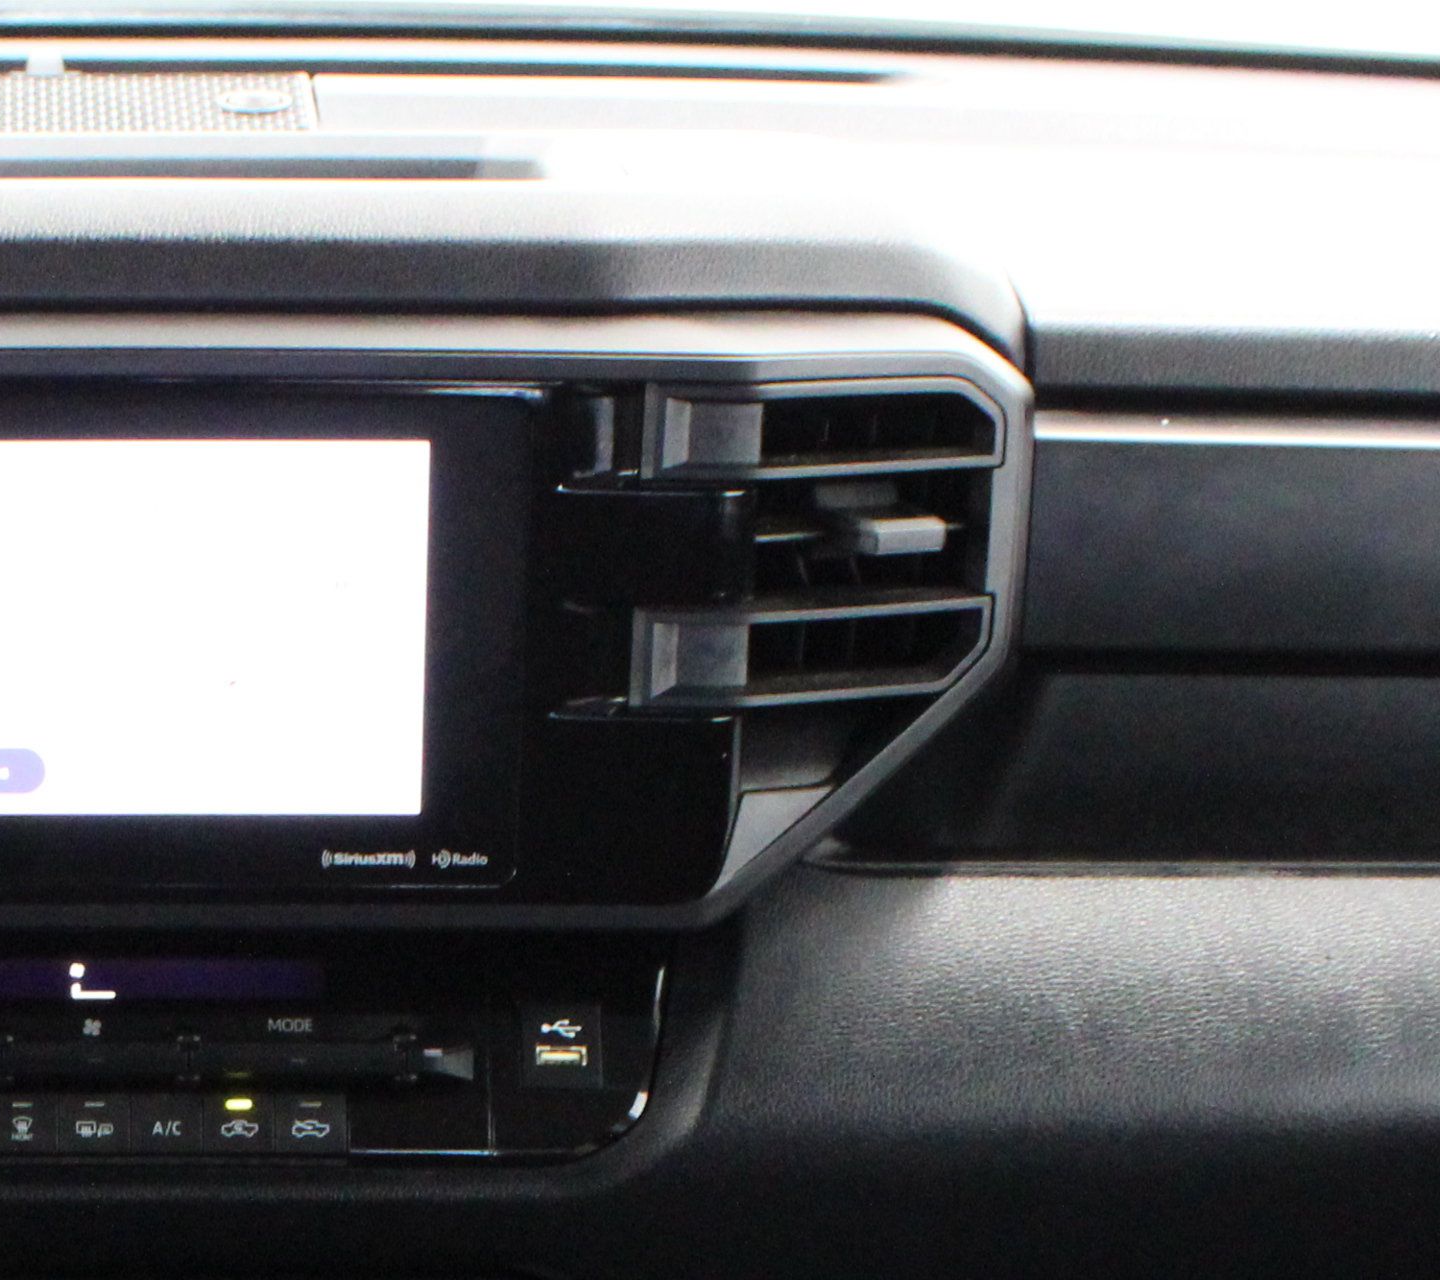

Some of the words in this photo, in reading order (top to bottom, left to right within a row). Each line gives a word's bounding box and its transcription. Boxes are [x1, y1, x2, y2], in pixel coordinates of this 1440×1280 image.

[453, 852, 489, 866] Radio
[267, 1017, 313, 1033] MODE
[152, 1120, 181, 1137] A/C
